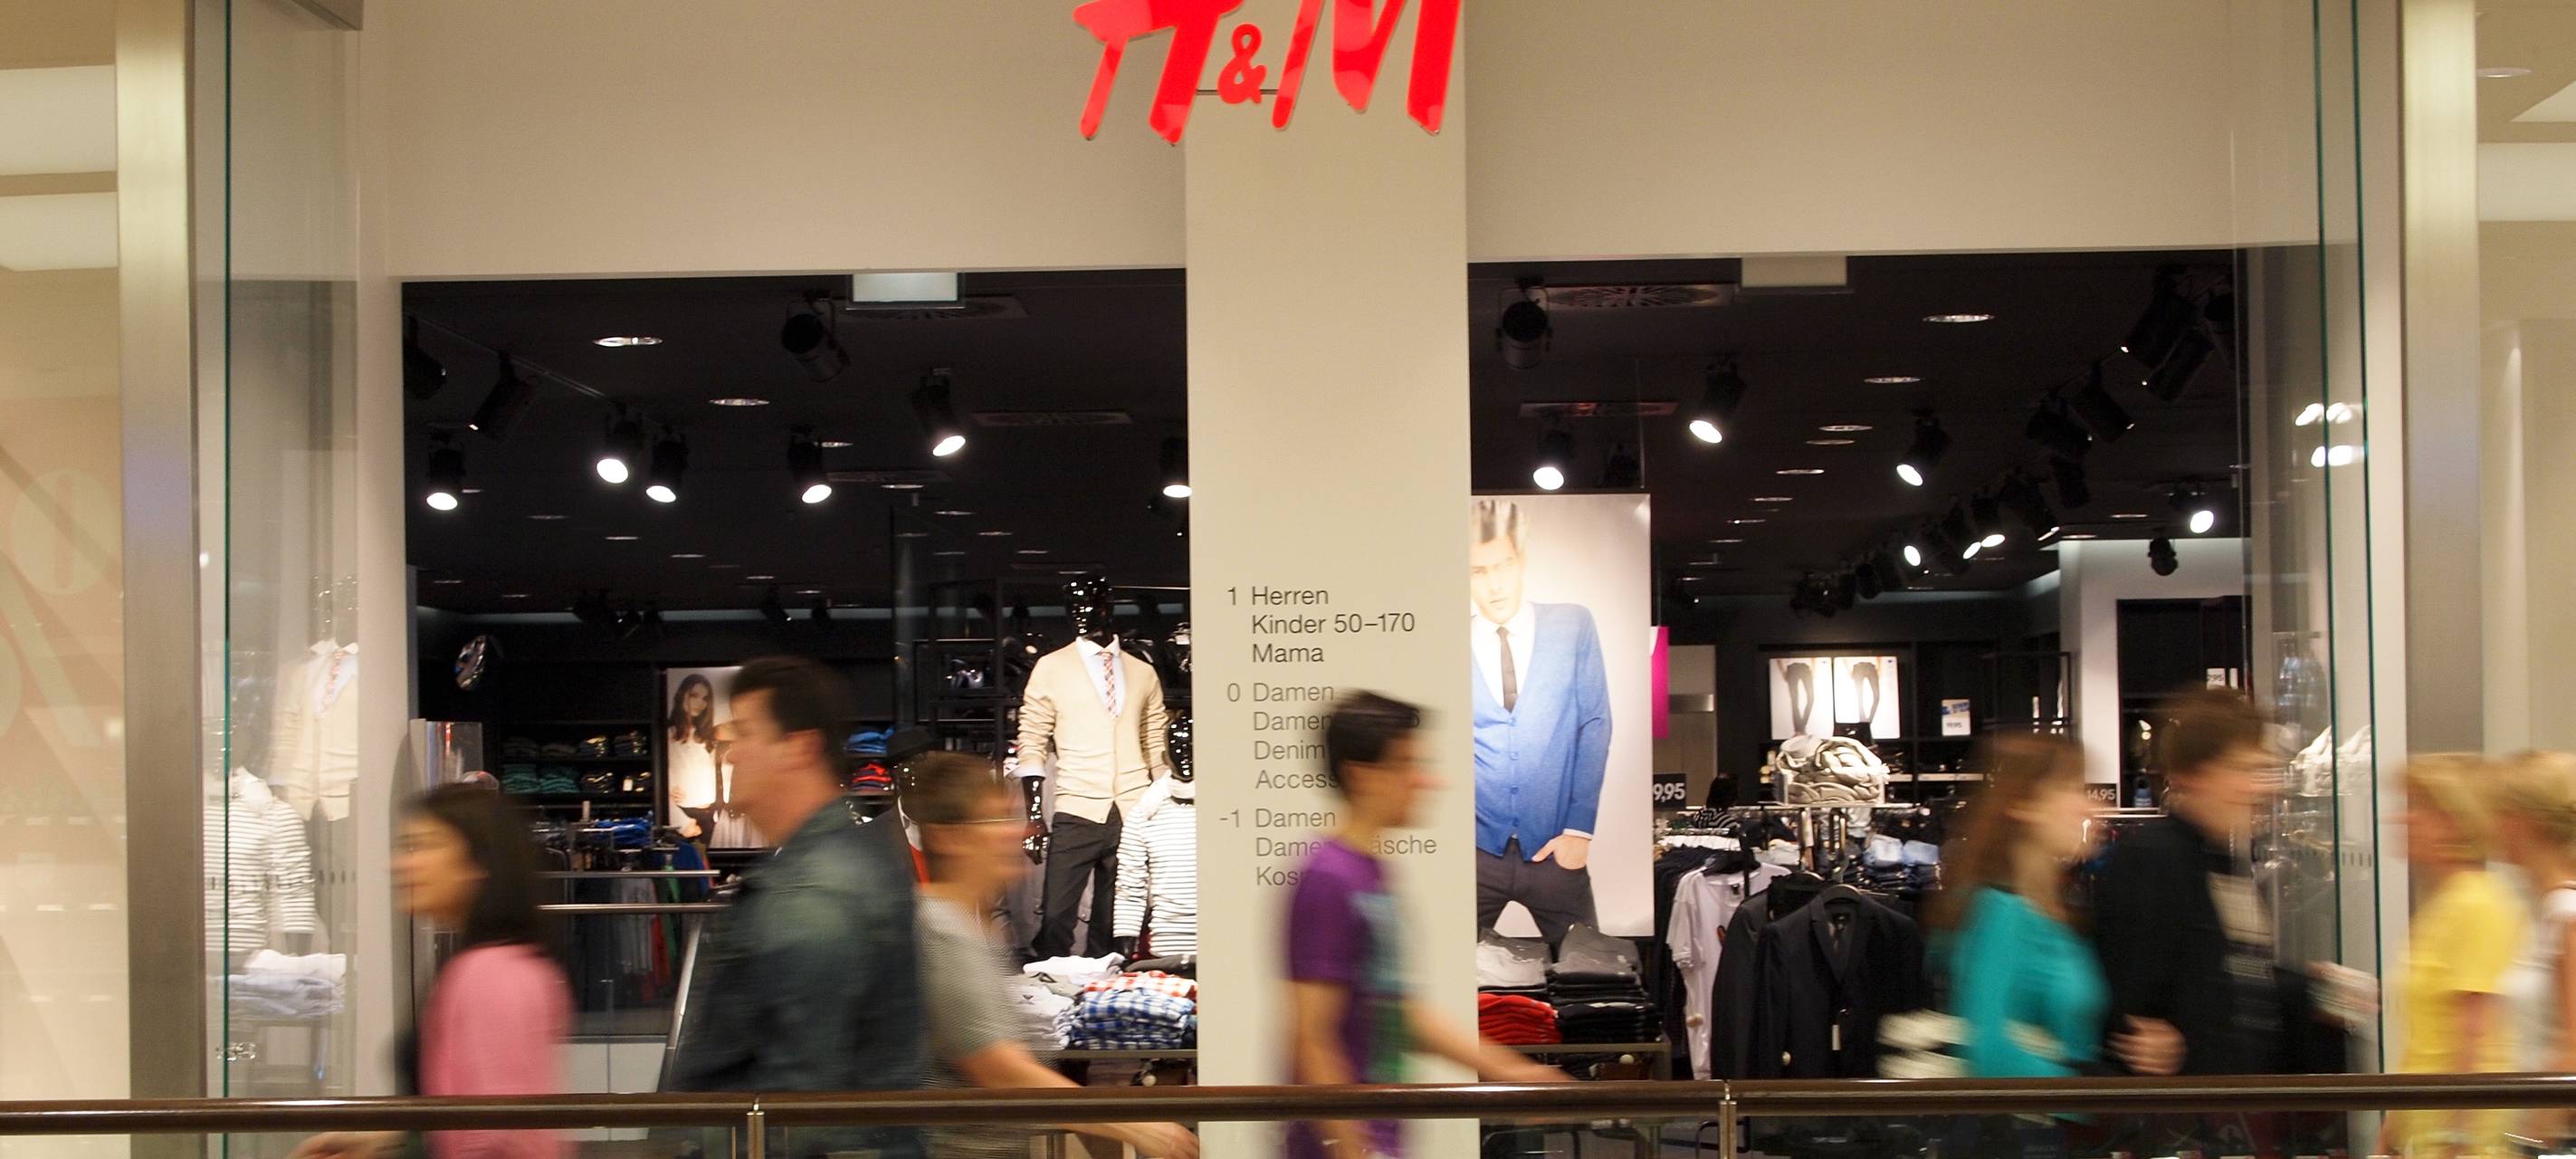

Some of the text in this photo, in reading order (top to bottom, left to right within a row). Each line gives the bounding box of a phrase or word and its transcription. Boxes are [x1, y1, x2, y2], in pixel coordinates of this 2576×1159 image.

[1073, 0, 1464, 144] H&M
[1227, 586, 1329, 606] 1 Herren
[1252, 614, 1327, 635] Kinder
[1253, 643, 1325, 663] Mama
[1226, 683, 1334, 702] 0 Damen
[1255, 740, 1326, 760] Denim
[1255, 770, 1340, 789] Access
[1219, 809, 1336, 829] -1 Damen
